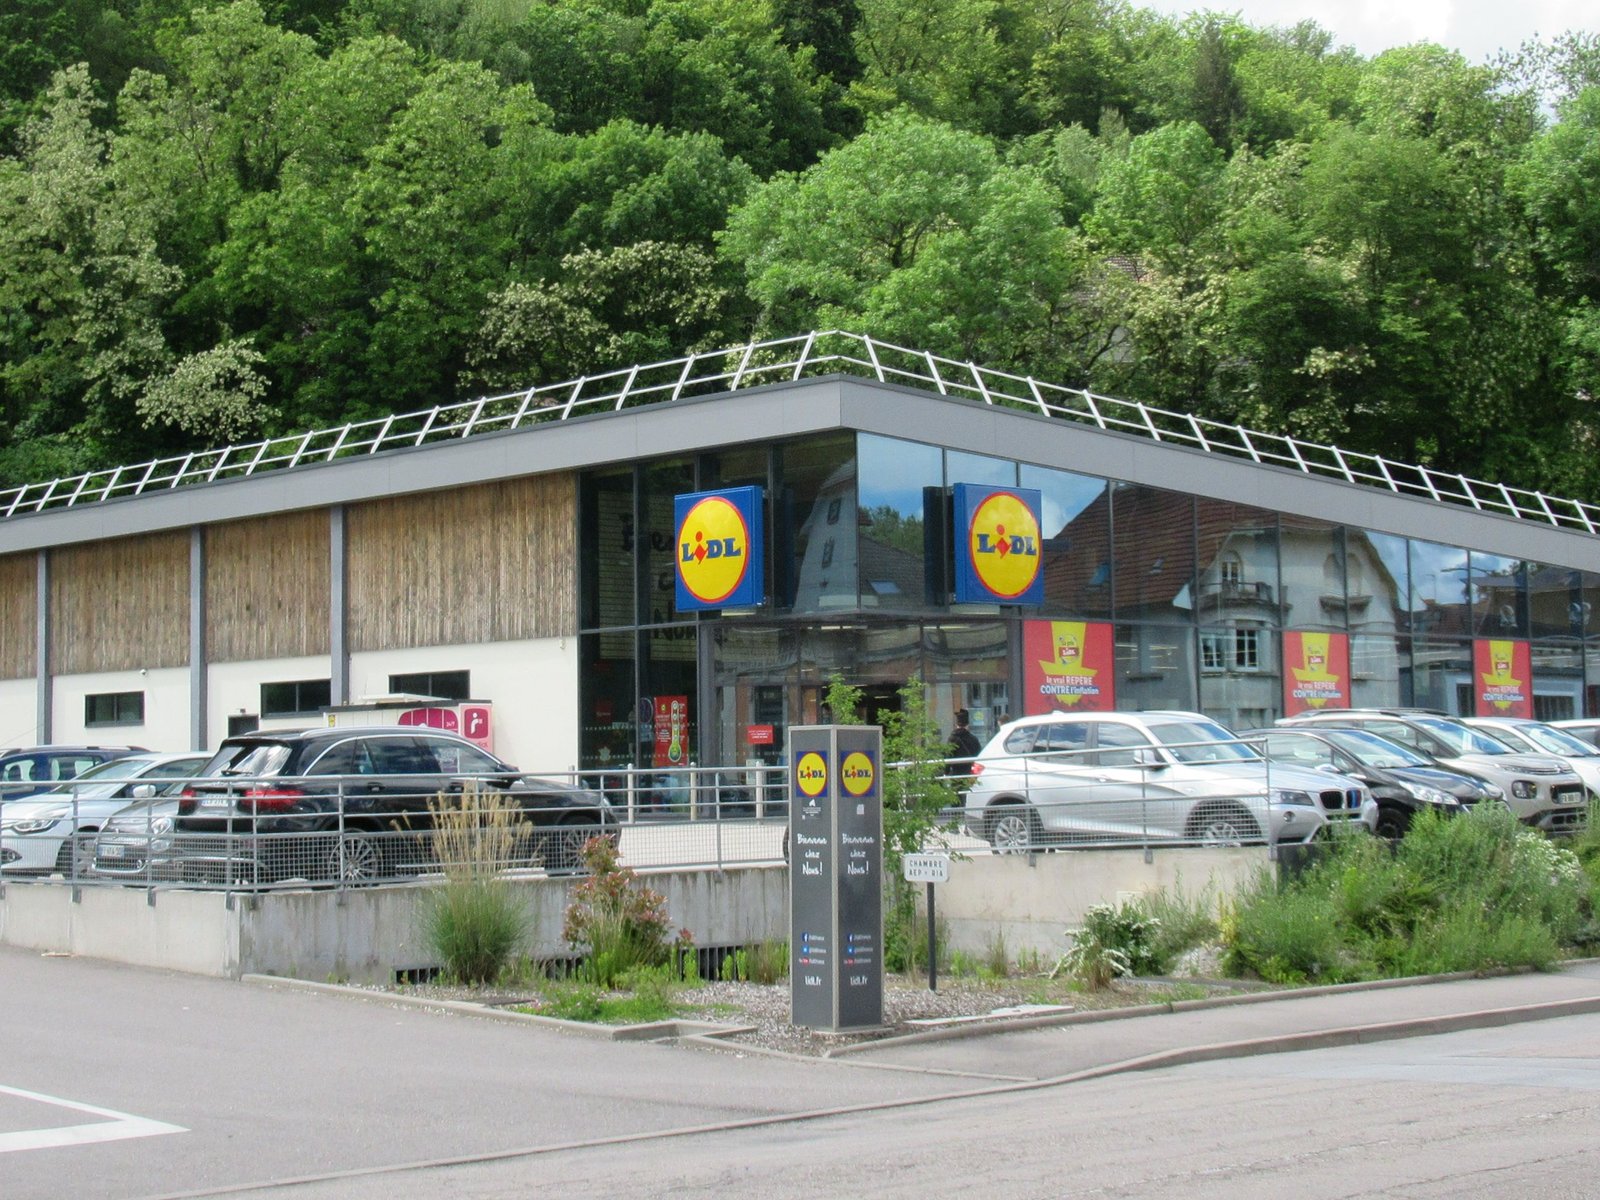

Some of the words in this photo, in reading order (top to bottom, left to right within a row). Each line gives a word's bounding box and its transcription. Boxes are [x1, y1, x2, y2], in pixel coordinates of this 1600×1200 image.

[1041, 685, 1069, 694] CONTRE
[804, 849, 820, 858] chez
[850, 849, 866, 858] chez
[909, 860, 942, 868] CHAMBRE
[909, 868, 922, 876] AEP
